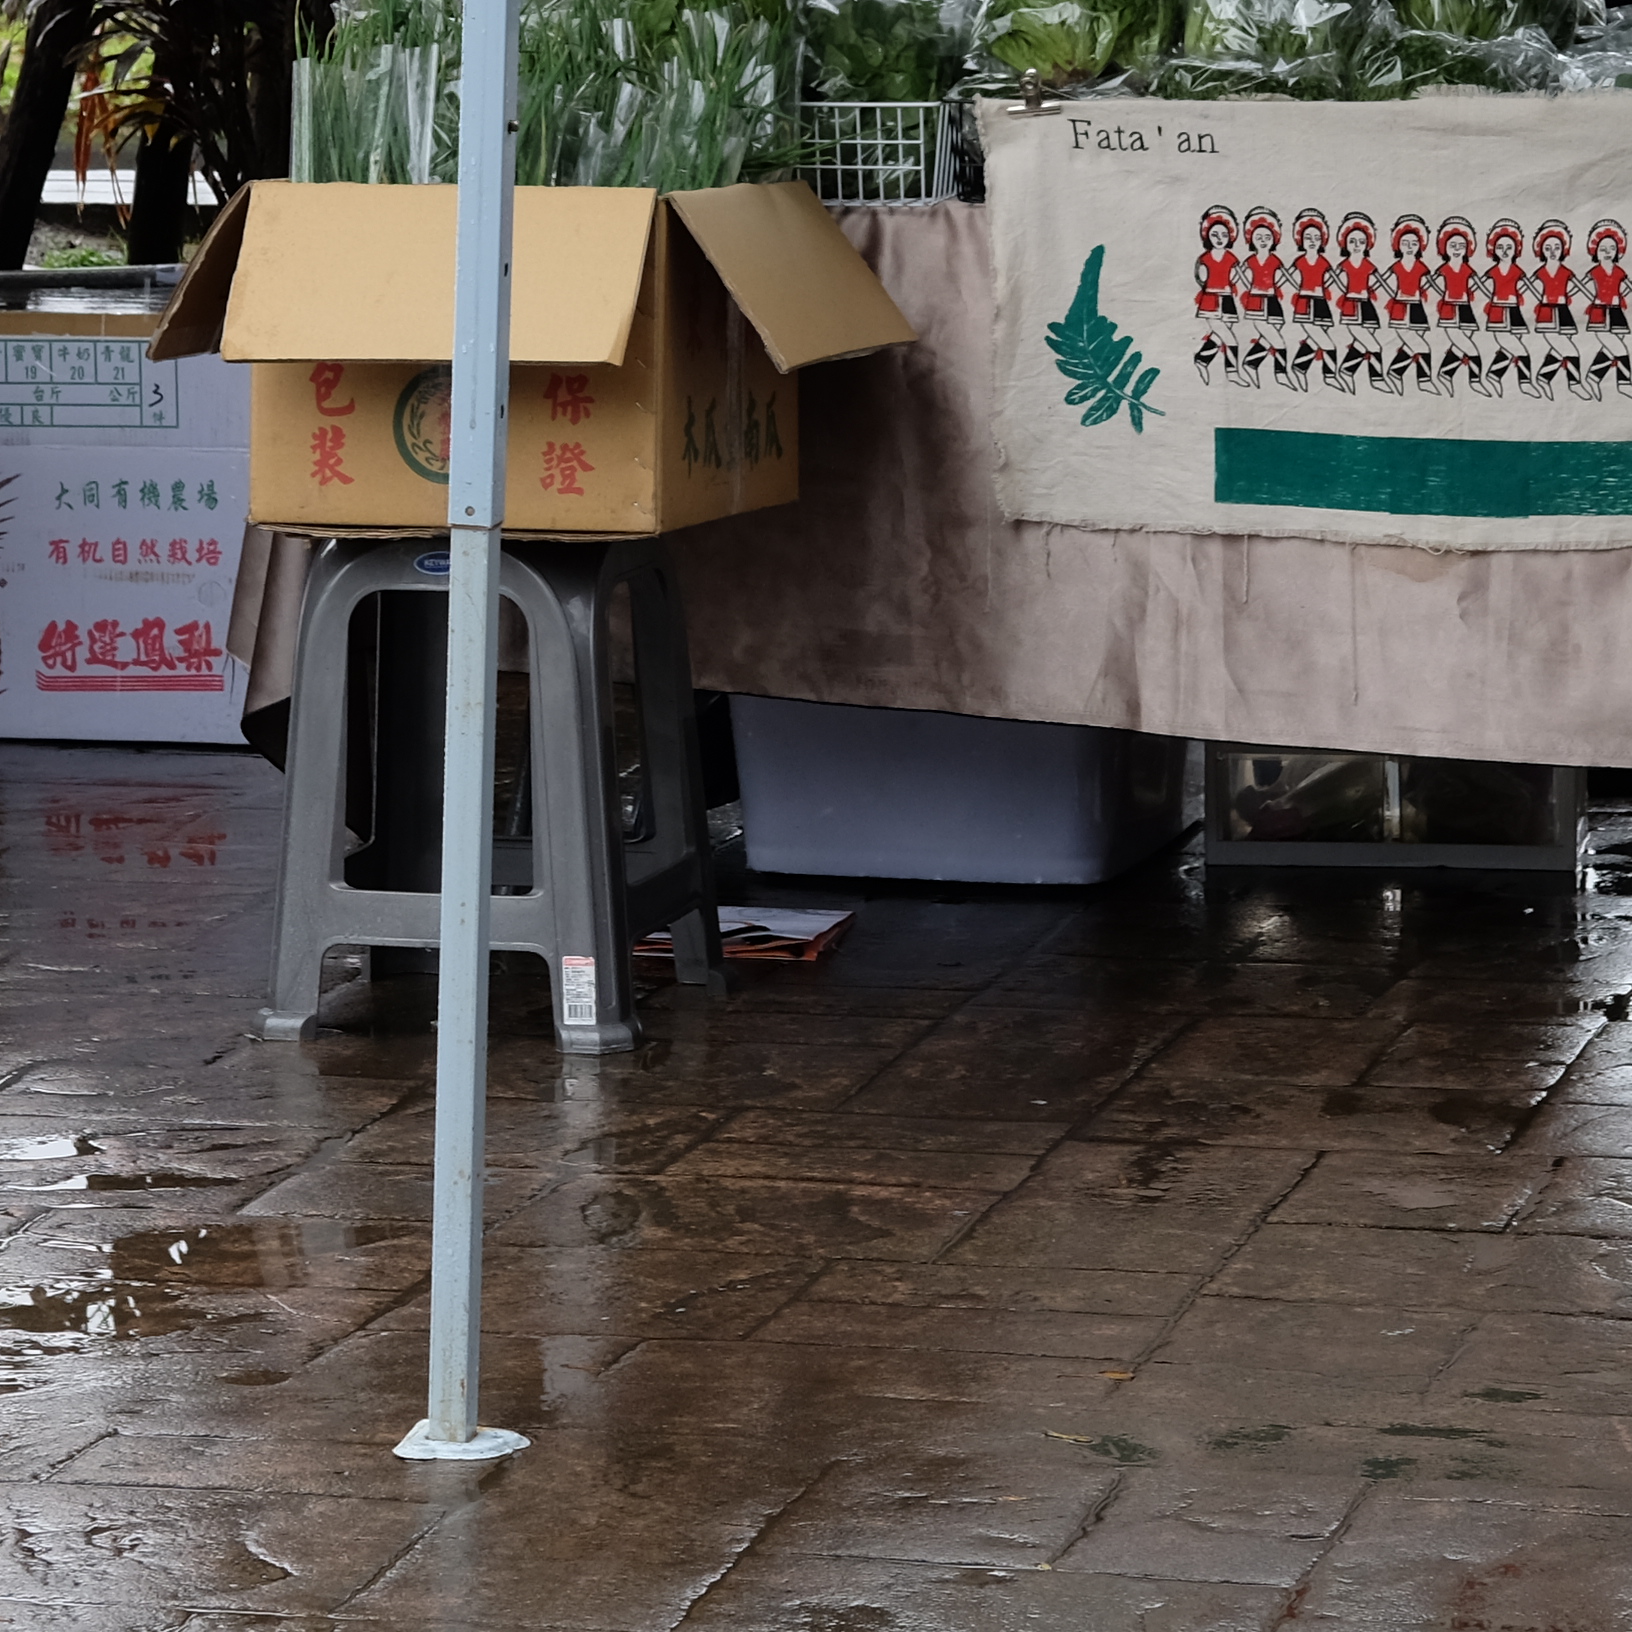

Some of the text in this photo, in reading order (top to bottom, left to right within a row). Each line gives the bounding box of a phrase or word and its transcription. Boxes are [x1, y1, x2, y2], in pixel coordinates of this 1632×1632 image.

[57, 344, 91, 362] 牛奶
[25, 366, 38, 381] 19
[70, 366, 85, 381] 20
[112, 366, 126, 381] 21
[148, 383, 164, 408] 3
[309, 361, 356, 486] 包裝
[539, 372, 596, 497] 保證
[55, 478, 219, 511] 大同有機農場
[38, 616, 223, 673] 特選鳳梨
